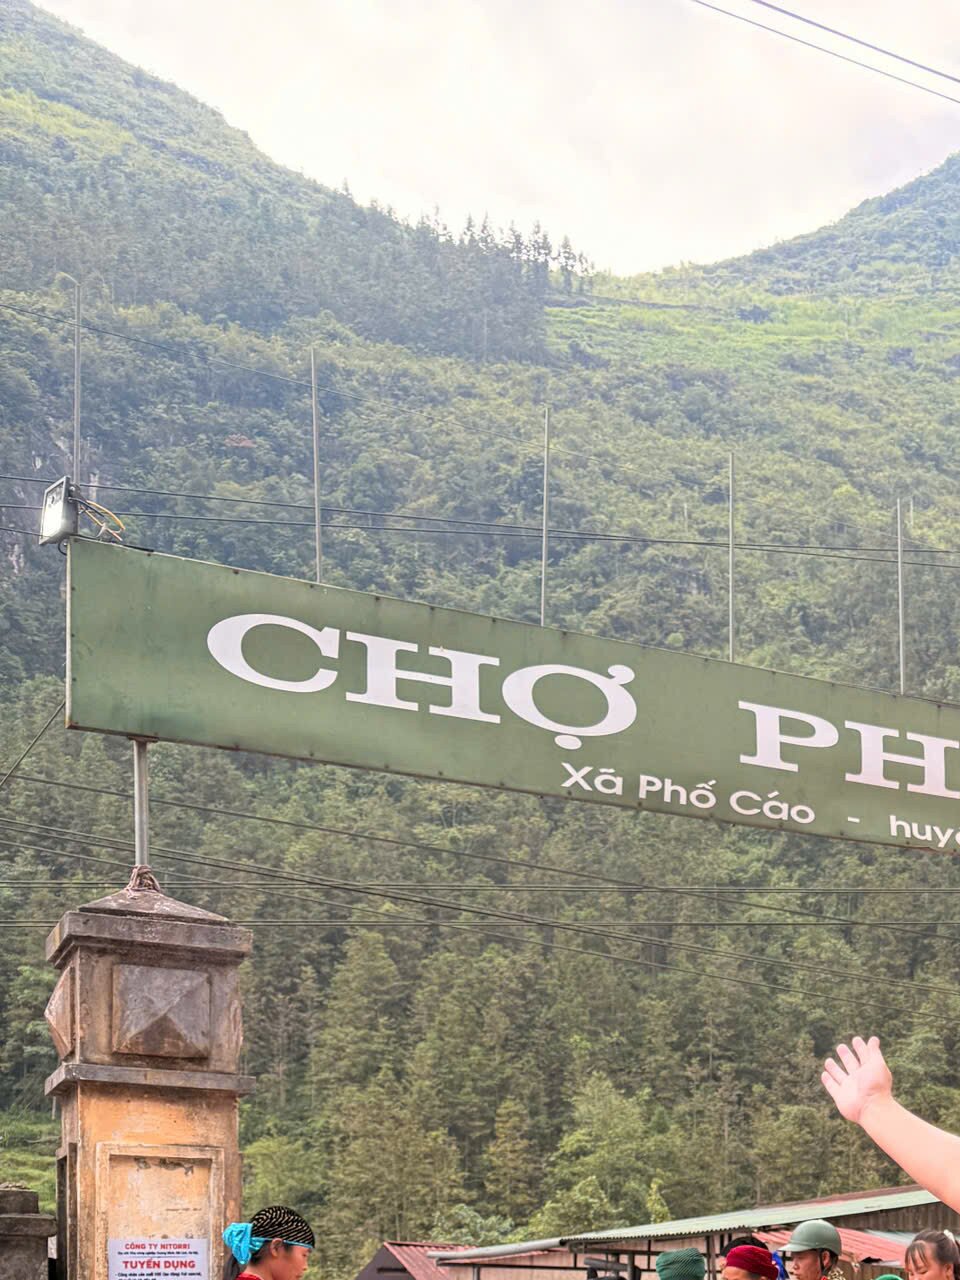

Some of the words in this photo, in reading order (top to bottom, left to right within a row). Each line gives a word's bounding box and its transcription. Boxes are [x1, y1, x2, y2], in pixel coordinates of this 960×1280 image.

[206, 613, 638, 750] CHỢ
[560, 761, 624, 796] Xã
[638, 774, 717, 809] Phố
[729, 790, 816, 824] Cáo
